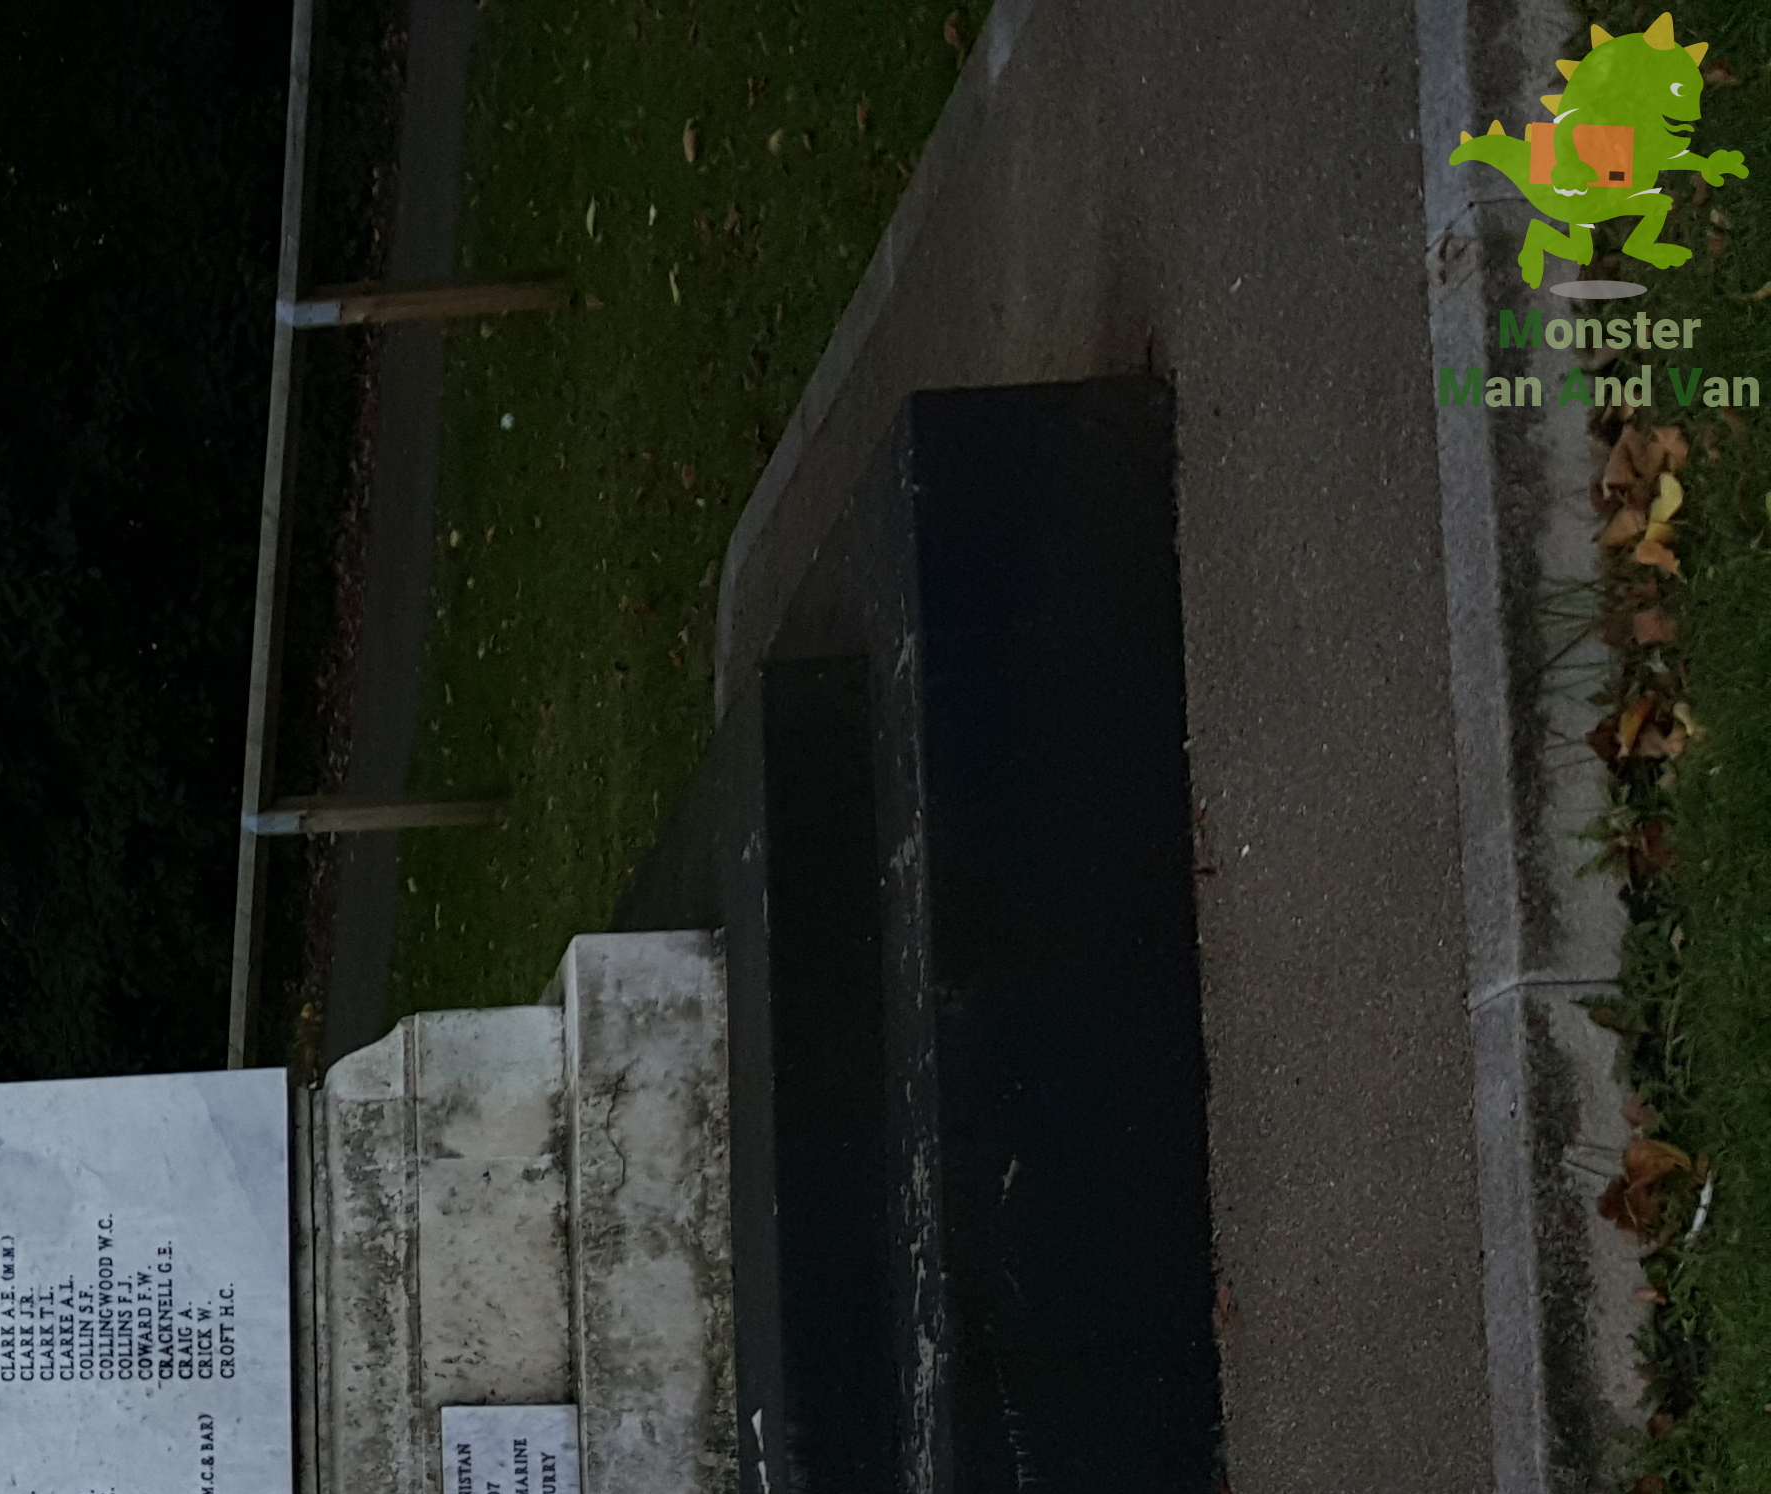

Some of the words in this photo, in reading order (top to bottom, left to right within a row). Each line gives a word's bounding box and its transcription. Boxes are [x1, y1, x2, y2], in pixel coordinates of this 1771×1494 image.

[98, 1213, 113, 1251] W.C.
[158, 1241, 172, 1273] G.E.
[1, 1286, 15, 1319] A.E.
[20, 1287, 34, 1318] J.R.
[39, 1285, 54, 1319] T.L.
[59, 1275, 74, 1308] A.L.
[79, 1285, 93, 1314] S.F.
[118, 1276, 132, 1304] F.J.
[137, 1266, 152, 1301] F.W.
[219, 1283, 234, 1317] H.C.
[99, 1257, 114, 1380] COLLINGWOOD
[179, 1302, 192, 1320] A.
[197, 1301, 211, 1322] W.
[60, 1314, 74, 1381] CLARKE
[118, 1310, 133, 1380] COLLINS
[138, 1308, 153, 1380] COWARD
[158, 1279, 173, 1382] CRACKNELL
[1, 1326, 15, 1382] CLARK
[20, 1325, 34, 1381] CLARK
[40, 1324, 54, 1381] CLARK
[79, 1320, 94, 1380] COLLIN
[178, 1327, 193, 1380] CRAIG
[198, 1329, 213, 1379] CRICK
[220, 1323, 235, 1379] CROFT
[198, 1413, 214, 1451] BAR)
